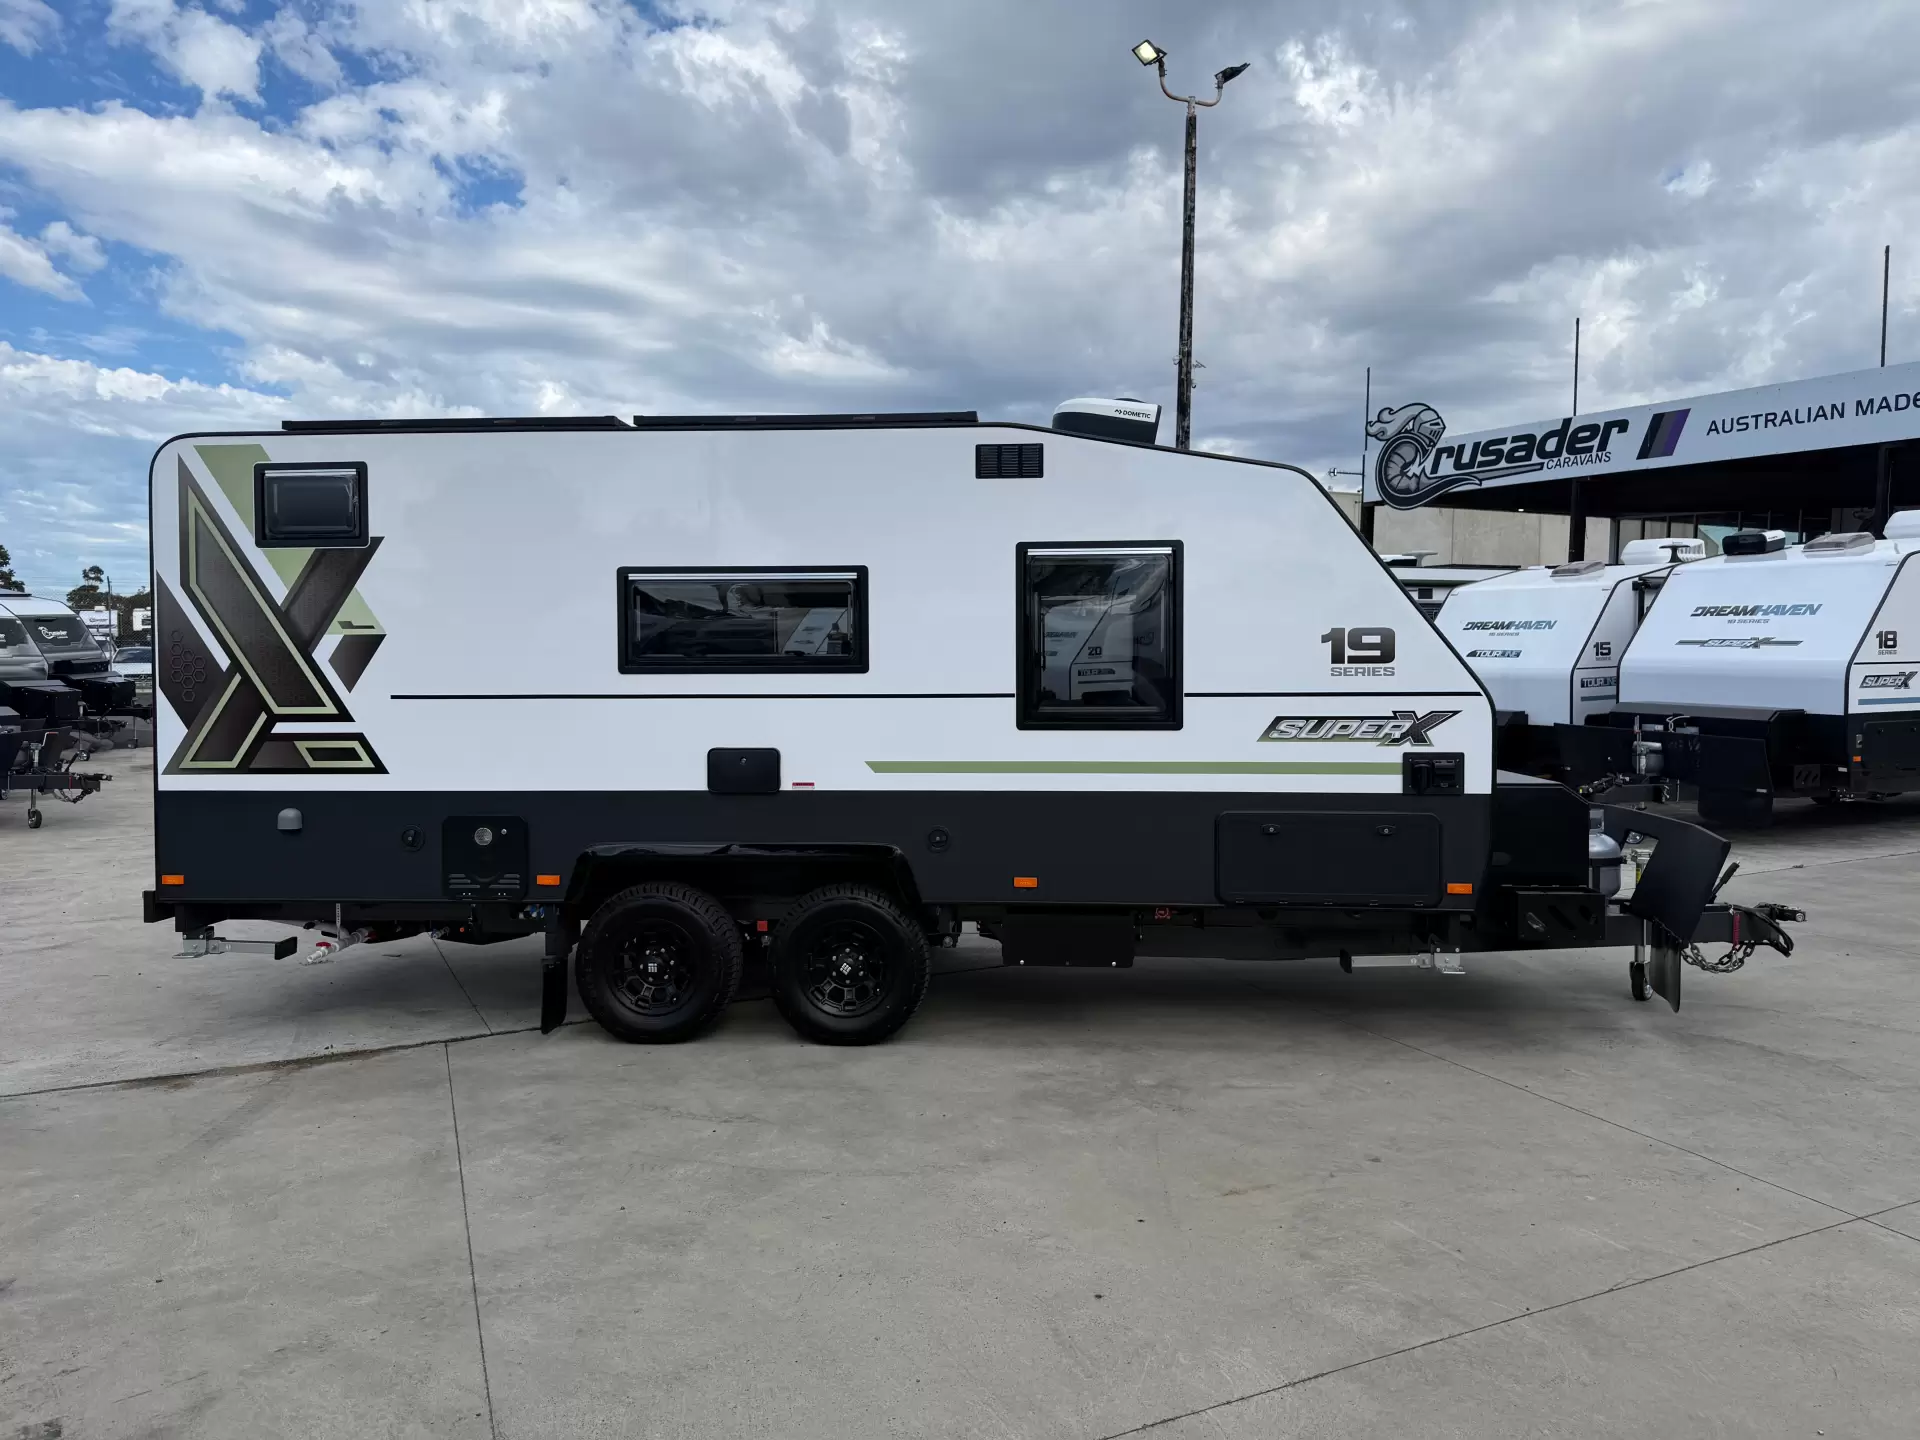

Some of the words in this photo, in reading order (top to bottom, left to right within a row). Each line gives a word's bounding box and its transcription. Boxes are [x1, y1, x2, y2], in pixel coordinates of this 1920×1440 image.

[1122, 409, 1151, 419] DOMETIC
[1706, 402, 1846, 436] AUSTRALIAN
[1546, 451, 1612, 471] CARAVANS
[1690, 603, 1823, 617] DREAMHAVEN
[1462, 620, 1558, 631] DREAMHAVEN
[1321, 627, 1396, 664] 19
[1876, 631, 1898, 649] 18
[1593, 642, 1611, 656] 15
[1331, 667, 1396, 677] SERIES
